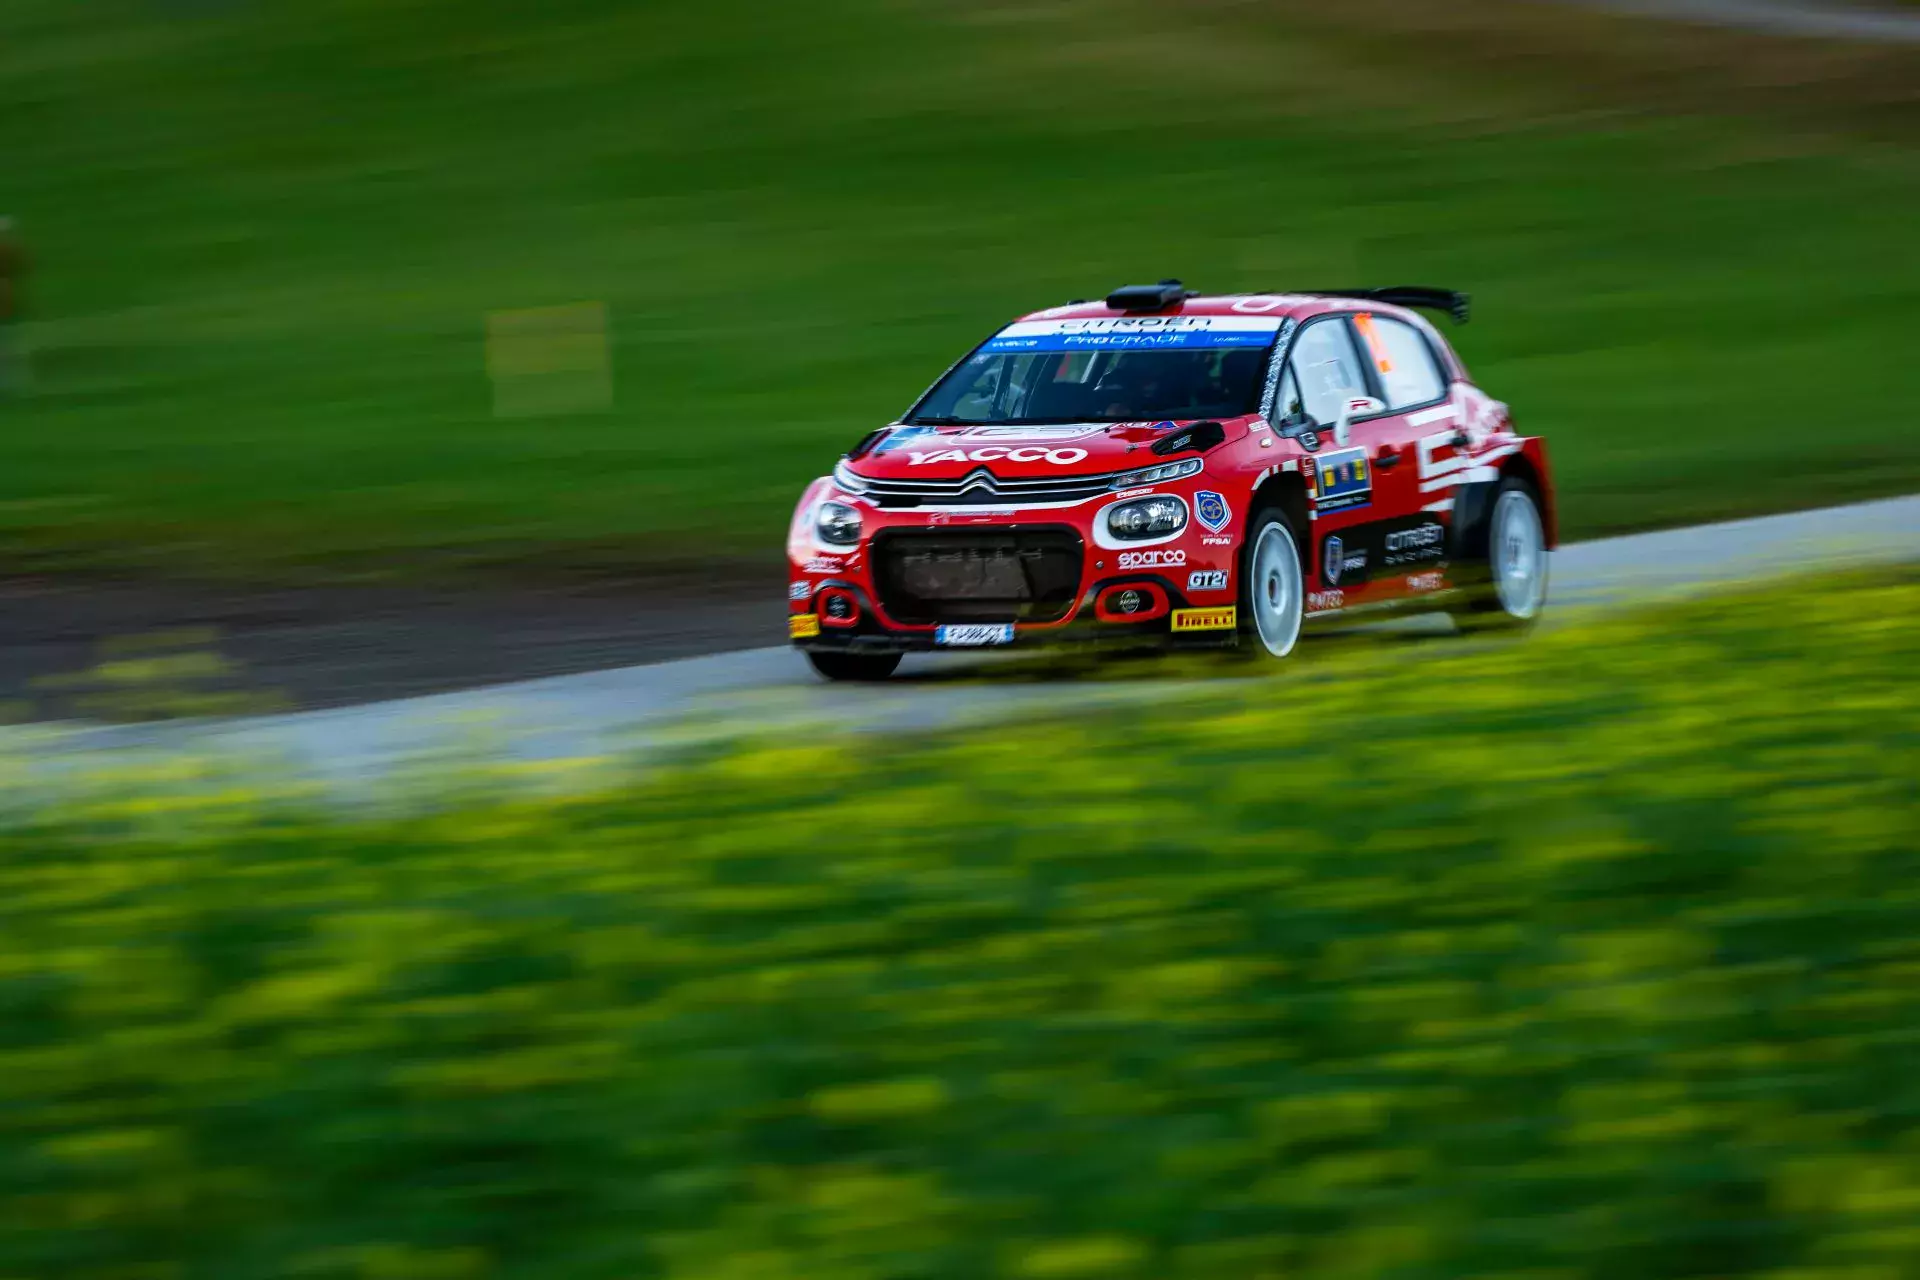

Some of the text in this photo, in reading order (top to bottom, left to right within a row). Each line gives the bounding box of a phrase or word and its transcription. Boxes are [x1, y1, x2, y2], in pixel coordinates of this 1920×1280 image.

[908, 446, 1089, 465] YACCO
[1118, 549, 1186, 571] sparco
[1189, 570, 1228, 587] GT2i
[1176, 611, 1234, 628] PIRELLI
